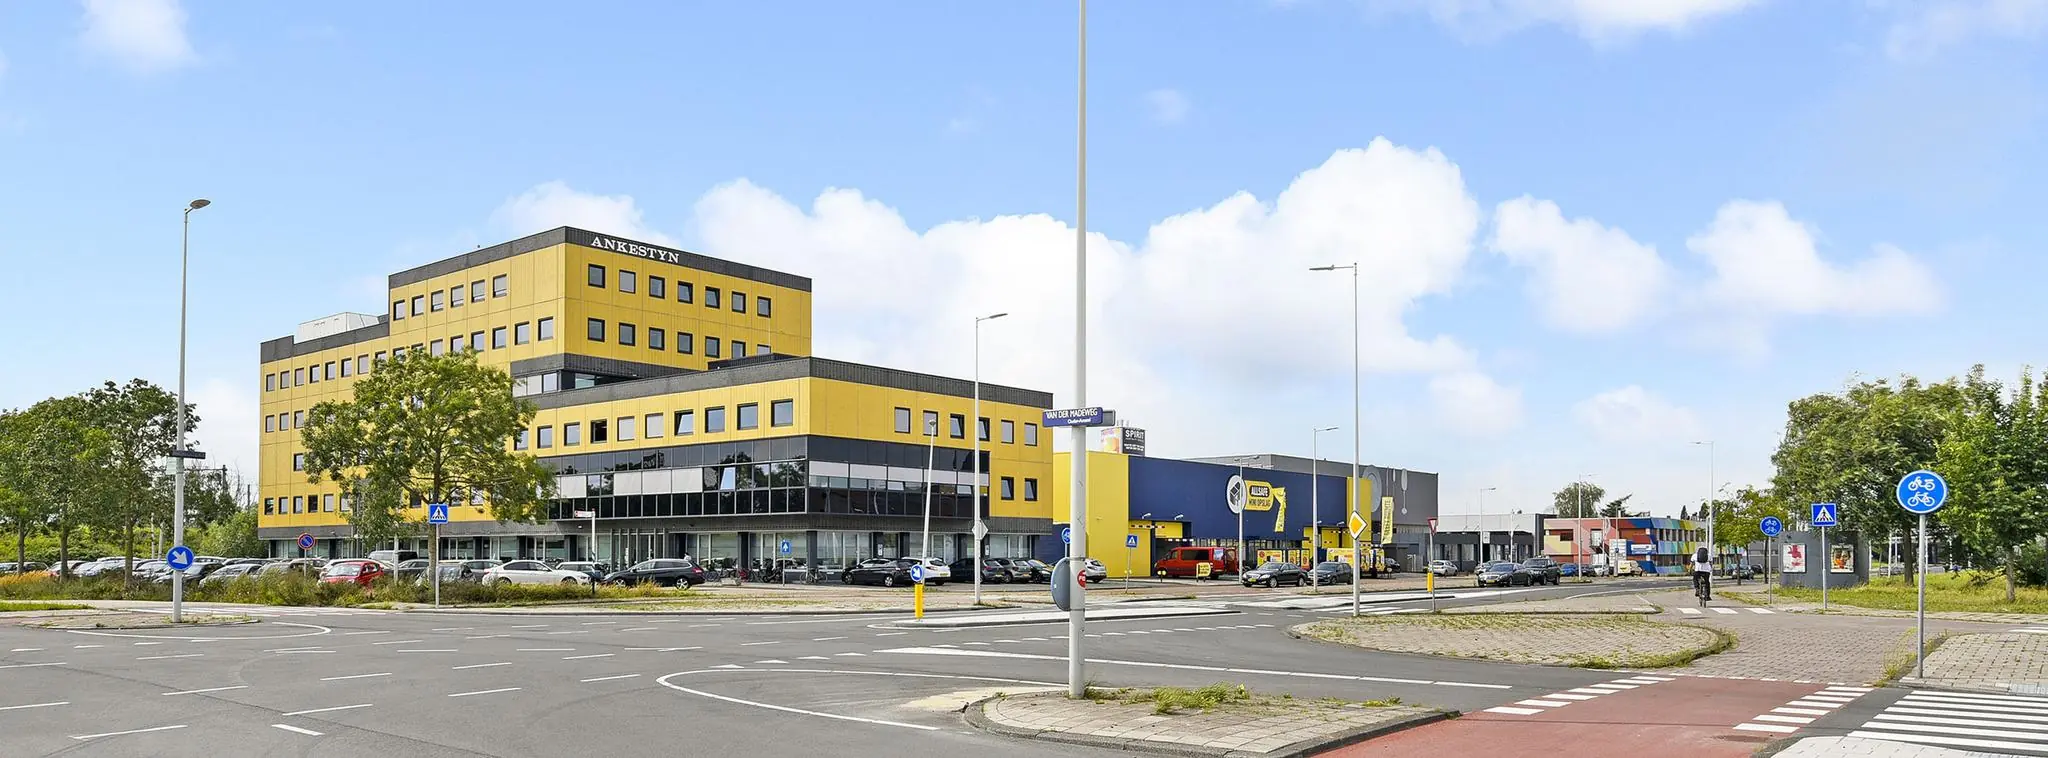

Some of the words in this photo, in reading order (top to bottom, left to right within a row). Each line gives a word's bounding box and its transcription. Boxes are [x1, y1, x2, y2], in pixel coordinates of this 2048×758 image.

[591, 236, 679, 263] ANKESTYN
[1046, 411, 1058, 419] VAN
[1058, 410, 1069, 419] DER
[1069, 408, 1098, 418] MADEWEG
[1125, 429, 1144, 439] SPIRIT
